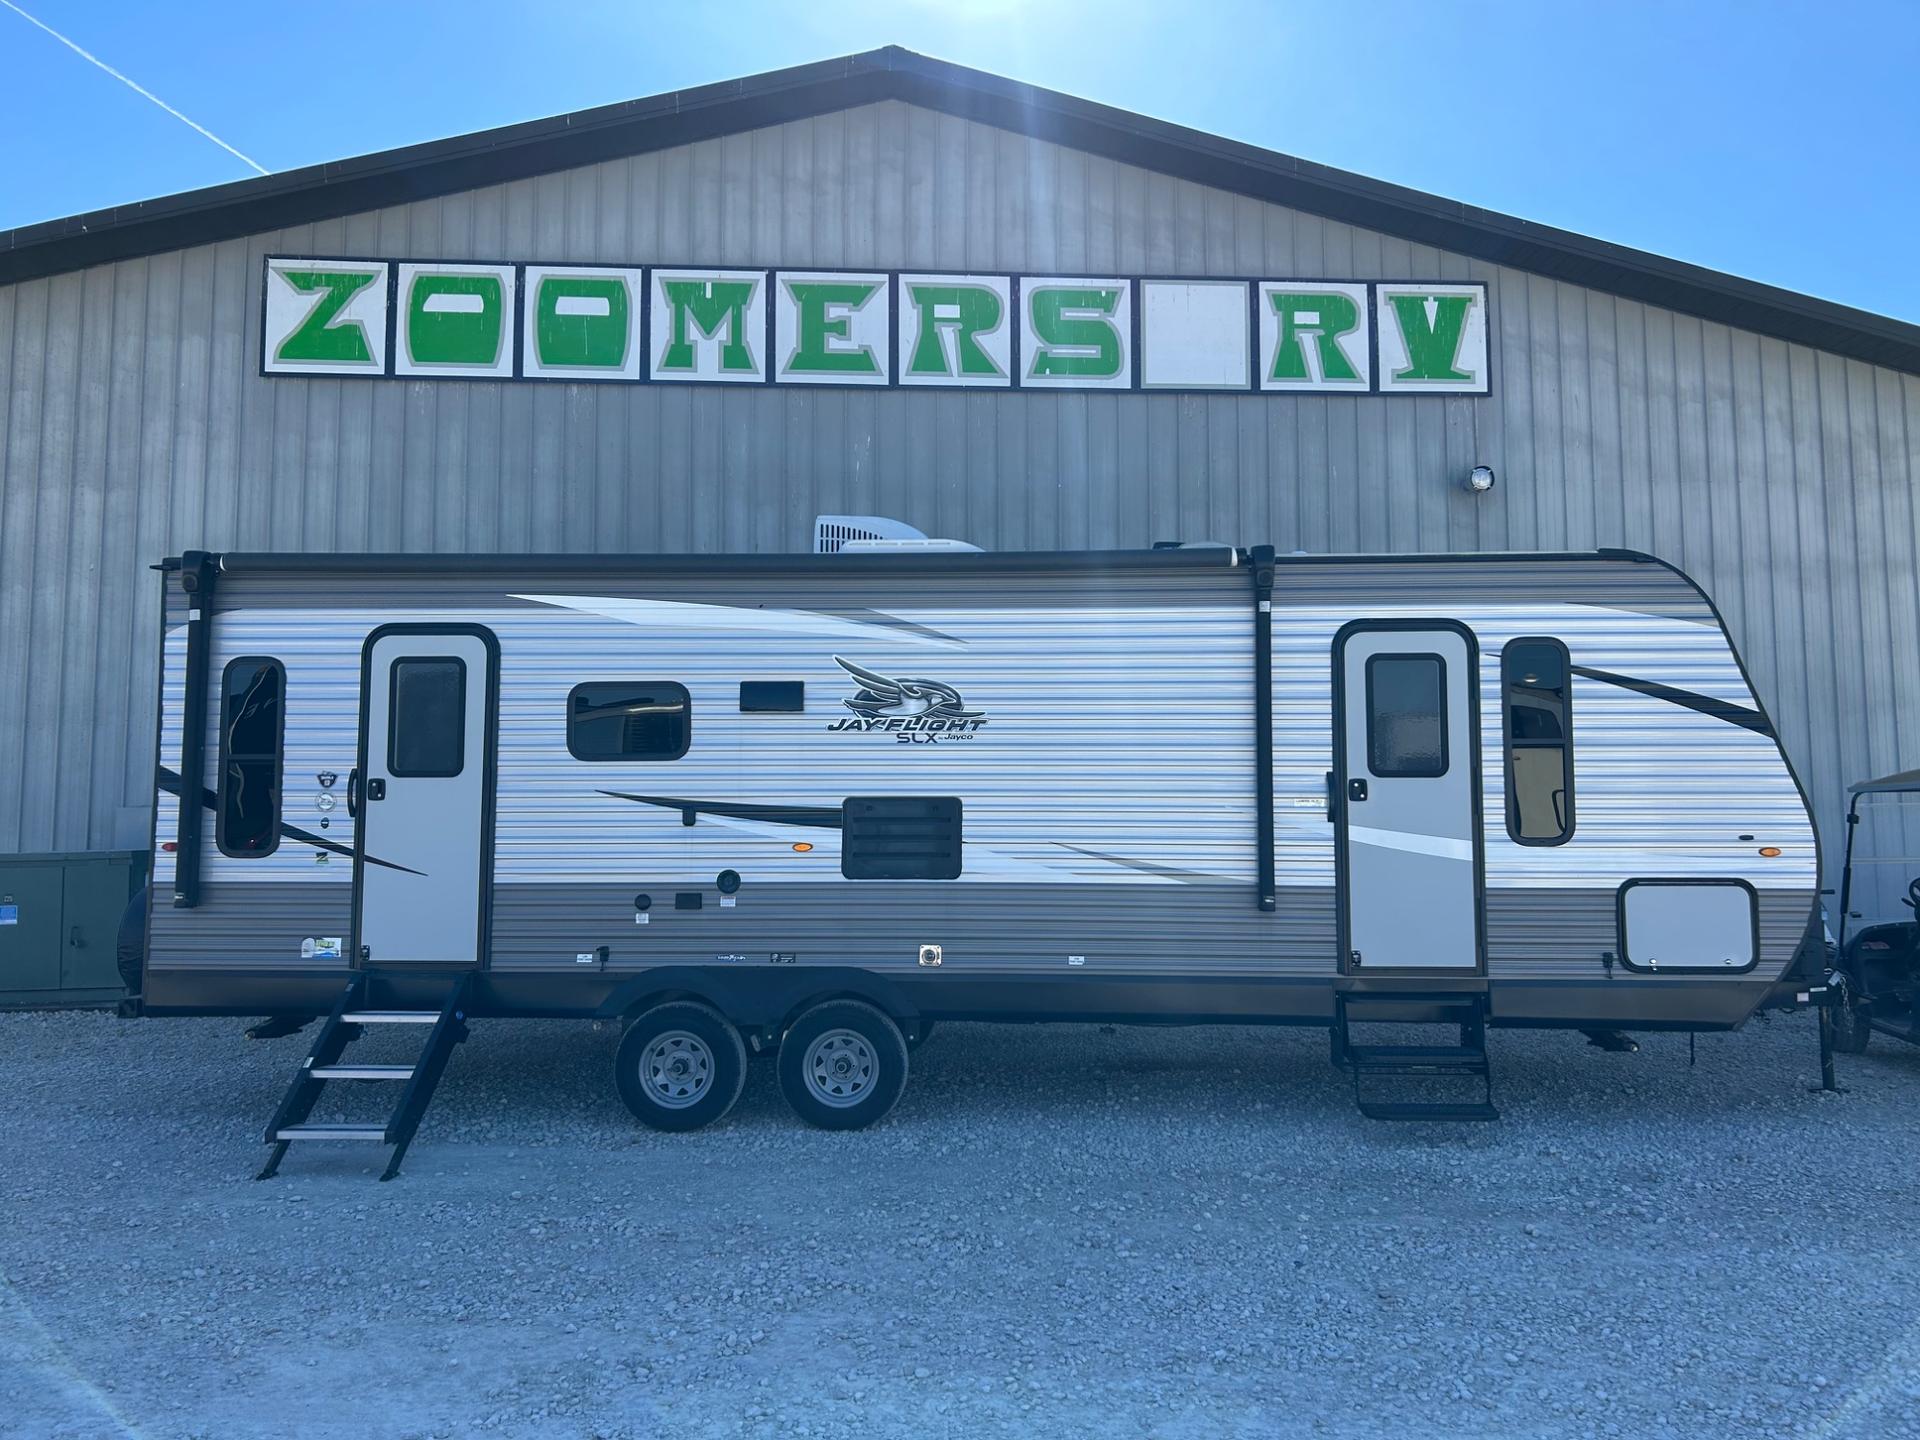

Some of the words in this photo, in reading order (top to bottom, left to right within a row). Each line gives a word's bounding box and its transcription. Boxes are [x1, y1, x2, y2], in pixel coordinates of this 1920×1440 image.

[271, 266, 1125, 380] ZOOMERS
[1266, 289, 1480, 384] RV
[896, 732, 938, 744] SLX
[944, 733, 974, 741] Jayco
